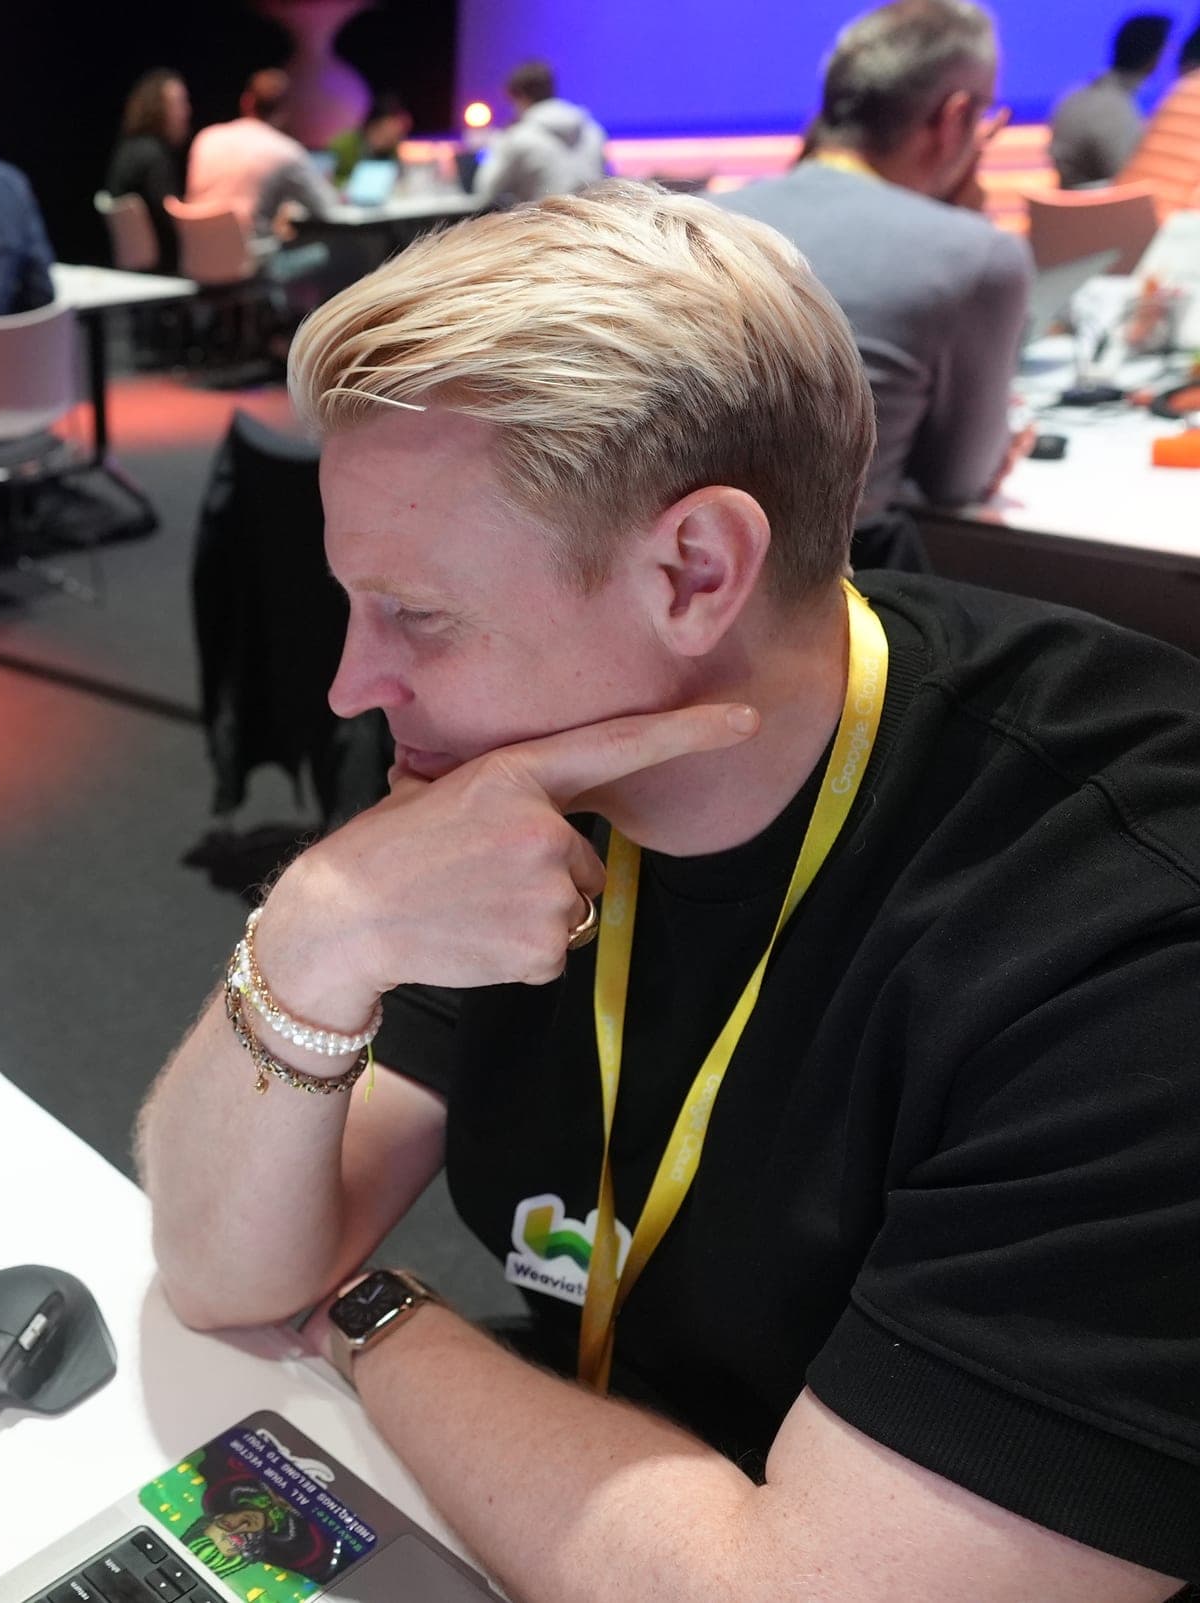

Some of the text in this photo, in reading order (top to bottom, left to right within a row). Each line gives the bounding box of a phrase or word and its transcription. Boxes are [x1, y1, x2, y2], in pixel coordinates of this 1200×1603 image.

[830, 656, 881, 795] Google Cloud
[513, 1261, 586, 1297] Weaviat
[229, 1439, 263, 1468] VECTOR
[266, 1450, 281, 1464] TO
[263, 1468, 288, 1490] YOUR
[280, 1462, 318, 1494] BELONG
[290, 1489, 311, 1507] ALL
[69, 1580, 91, 1602] return
